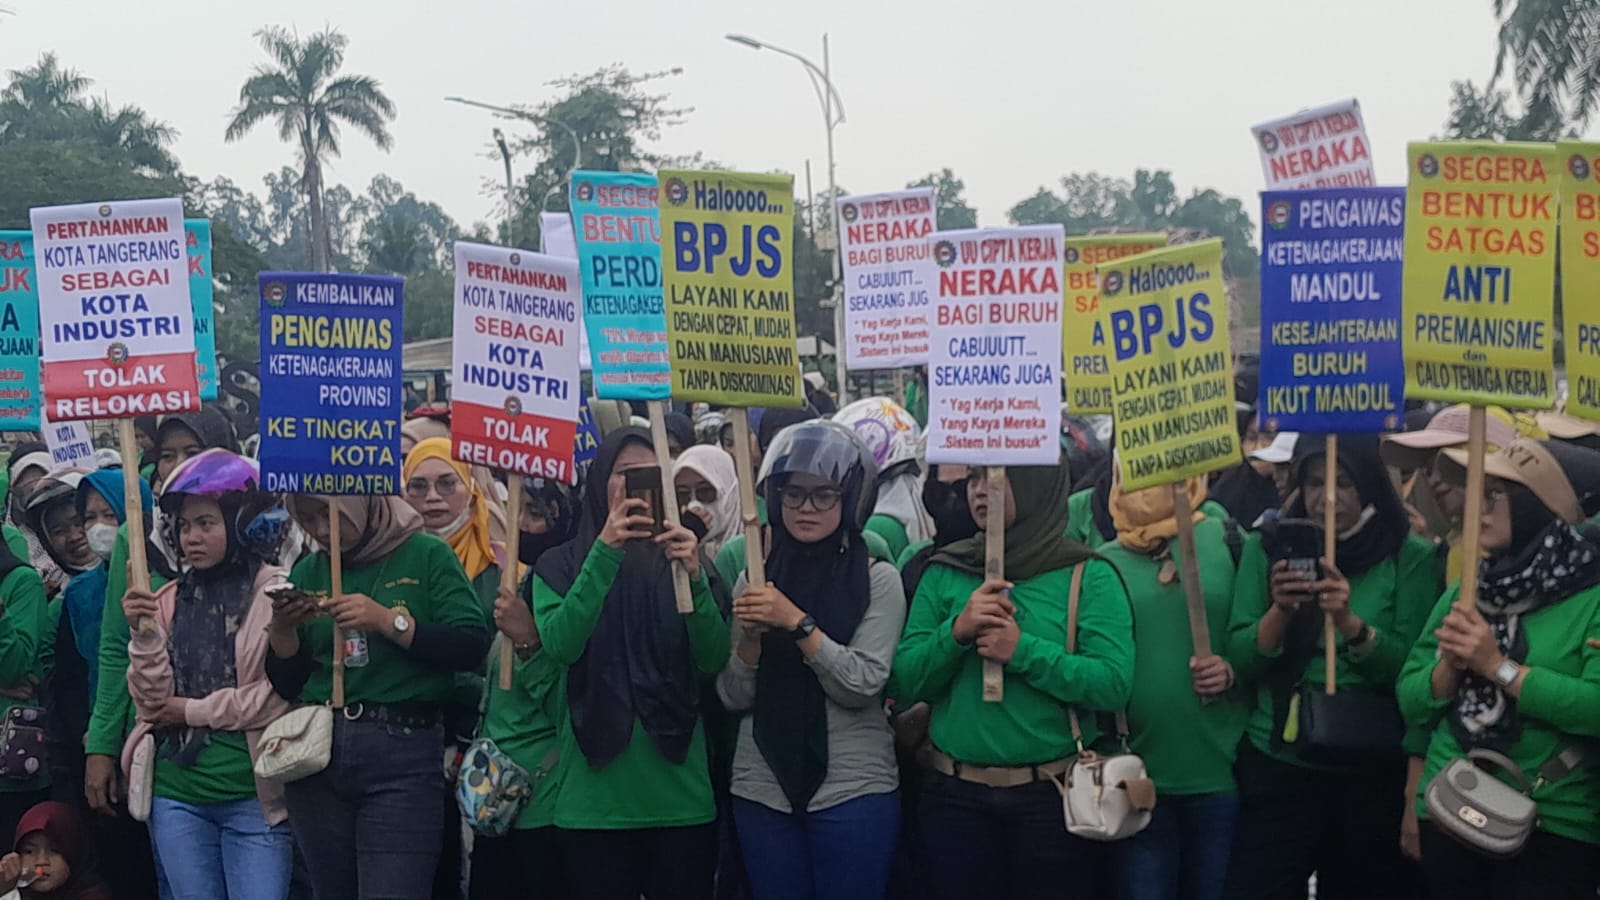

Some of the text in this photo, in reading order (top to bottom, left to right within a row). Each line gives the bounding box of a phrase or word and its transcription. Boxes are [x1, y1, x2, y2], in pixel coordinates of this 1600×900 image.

[1270, 136, 1368, 182] NERAKA
[1443, 156, 1546, 184] SEGERA
[694, 180, 782, 213] Haloooo...
[1423, 191, 1552, 220] BENTUK
[1300, 197, 1402, 229] PENGAWAS
[47, 217, 168, 240] PERTAHANKAN
[848, 218, 932, 244] NERAKA
[1426, 226, 1544, 256] SATGAS
[44, 240, 180, 268] KOTA TANGERANG
[674, 221, 781, 278] BPJS
[849, 249, 881, 266] BAGI
[961, 238, 1057, 264] UU CIPTA KERJA
[1268, 238, 1402, 266] KETENAGAKERJAAN
[61, 268, 170, 292] SEBAGAI
[468, 261, 566, 292] PERTAHANKAN
[592, 255, 663, 288] PERD
[940, 267, 1058, 296] NERAKA
[1130, 262, 1209, 295] Haloooo...
[1443, 265, 1510, 303] ANTI
[297, 283, 394, 306] KEMBALIKAN
[672, 284, 790, 312] LAYANI KAMI
[1291, 271, 1380, 302] MANDUL
[82, 294, 148, 316] KOTA
[464, 285, 574, 322] KOTA TANGERANG
[850, 292, 905, 311] SEKARANG
[938, 302, 1058, 325] BAGI BURUH
[54, 316, 180, 342] INDUSTRI
[271, 315, 392, 350] PENGAWAS
[475, 316, 563, 346] SEBAGAI
[674, 312, 791, 340] DENGAN CEPAT, MUDAH
[1110, 292, 1214, 361] BPJS
[1272, 318, 1396, 345] KESEJAHTERAAN
[1416, 314, 1544, 349] PREMANISME
[270, 355, 392, 378] KETENAGAKERJAAN
[489, 343, 543, 370] KOTA
[676, 340, 706, 361] DAN
[710, 342, 793, 366] MANUSIAWI
[1293, 351, 1366, 377] BURUH
[1463, 351, 1486, 362] dan
[84, 365, 166, 388] TOLAK
[464, 364, 568, 400] INDUSTRI
[680, 369, 718, 391] TANPA
[720, 372, 794, 396] DISKRIMINASI
[936, 364, 1052, 386] SEKARANG JUGA
[1114, 352, 1224, 395] LAYANI KAMI
[1416, 361, 1548, 398] CALO TENAGA KERJA
[57, 391, 190, 418] RELOKASI
[320, 385, 390, 406] PROVINSI
[975, 398, 1004, 413] Kerja
[1008, 397, 1040, 410] Kami,
[1075, 388, 1099, 408] CALO
[1118, 379, 1226, 422] DENGAN CEPAT, MUDAH
[1268, 382, 1394, 414] IKUT MANDUL
[56, 426, 75, 442] KOTA
[268, 418, 396, 439] KE TINGKAT
[484, 417, 549, 448] TOLAK
[941, 416, 1045, 432] Yang Kaya Mereka
[1121, 406, 1228, 450] DAN MANUSIAWI
[53, 442, 91, 463] INDUSTRI
[331, 446, 394, 466] KOTA
[459, 441, 565, 480] RELOKASI
[1128, 436, 1232, 479] TANPA DISKRIMINASI
[268, 472, 393, 494] DAN KABUPATEN
